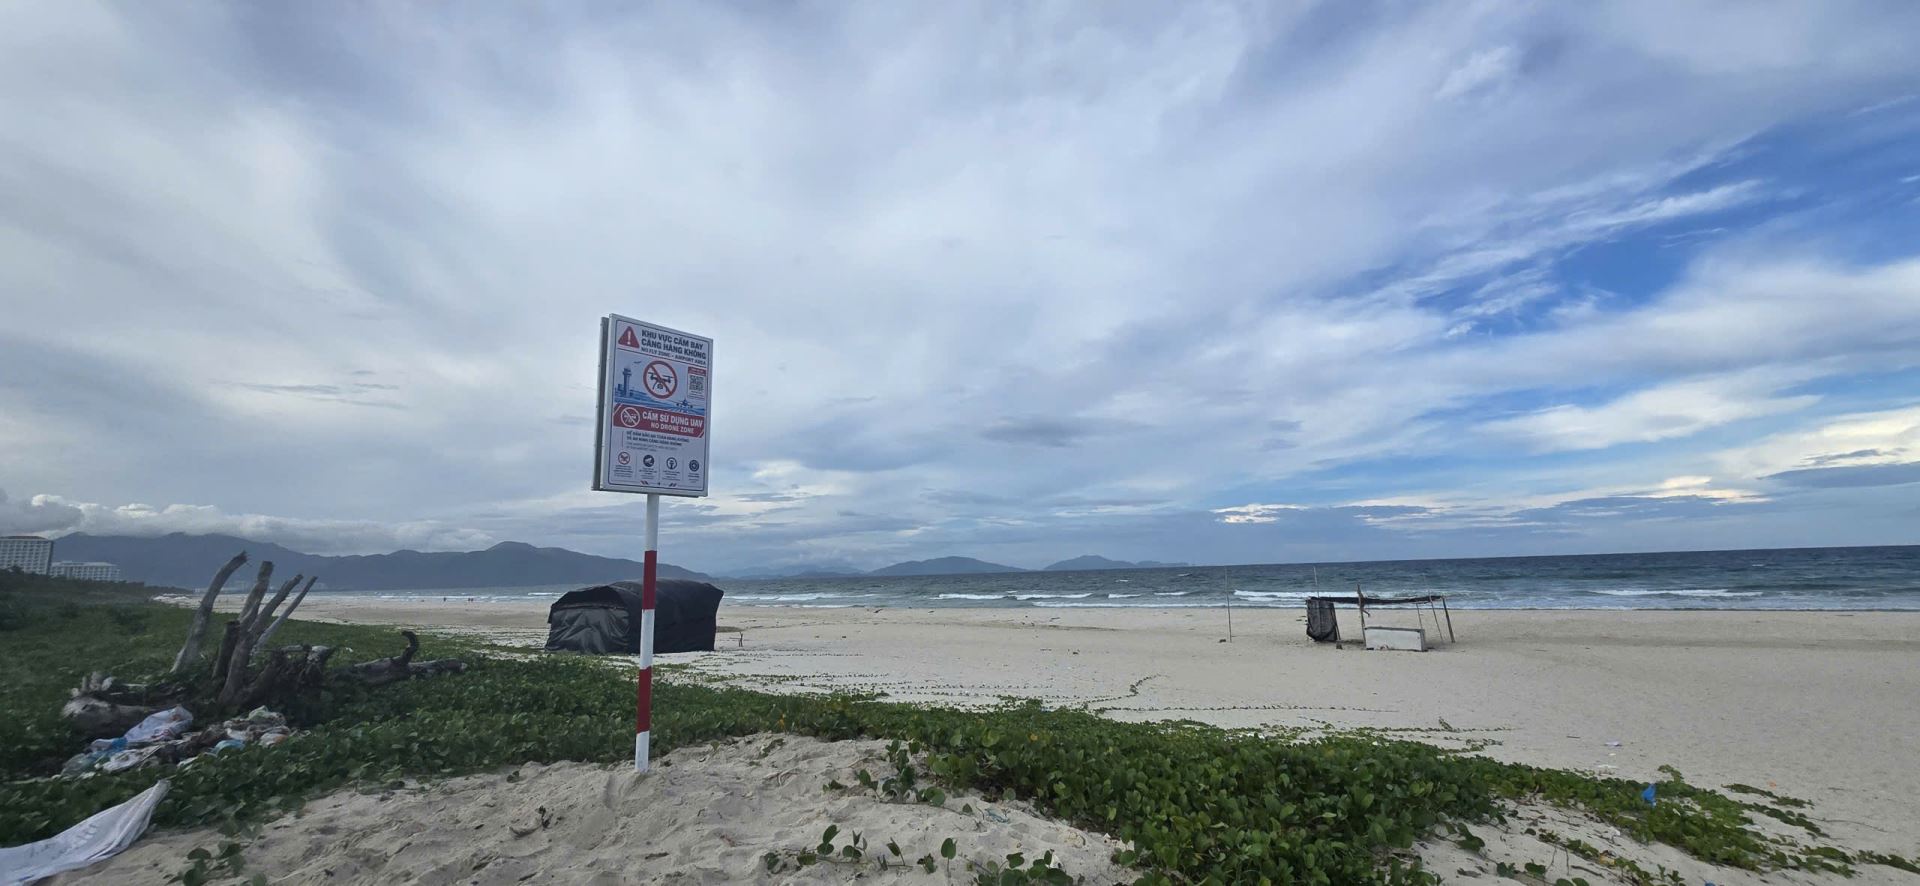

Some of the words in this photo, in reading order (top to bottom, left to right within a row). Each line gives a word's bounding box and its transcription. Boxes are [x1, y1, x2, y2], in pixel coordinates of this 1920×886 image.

[642, 329, 657, 340] KHU
[690, 341, 704, 350] BAY
[690, 418, 703, 427] UAV
[660, 424, 679, 432] DRONE
